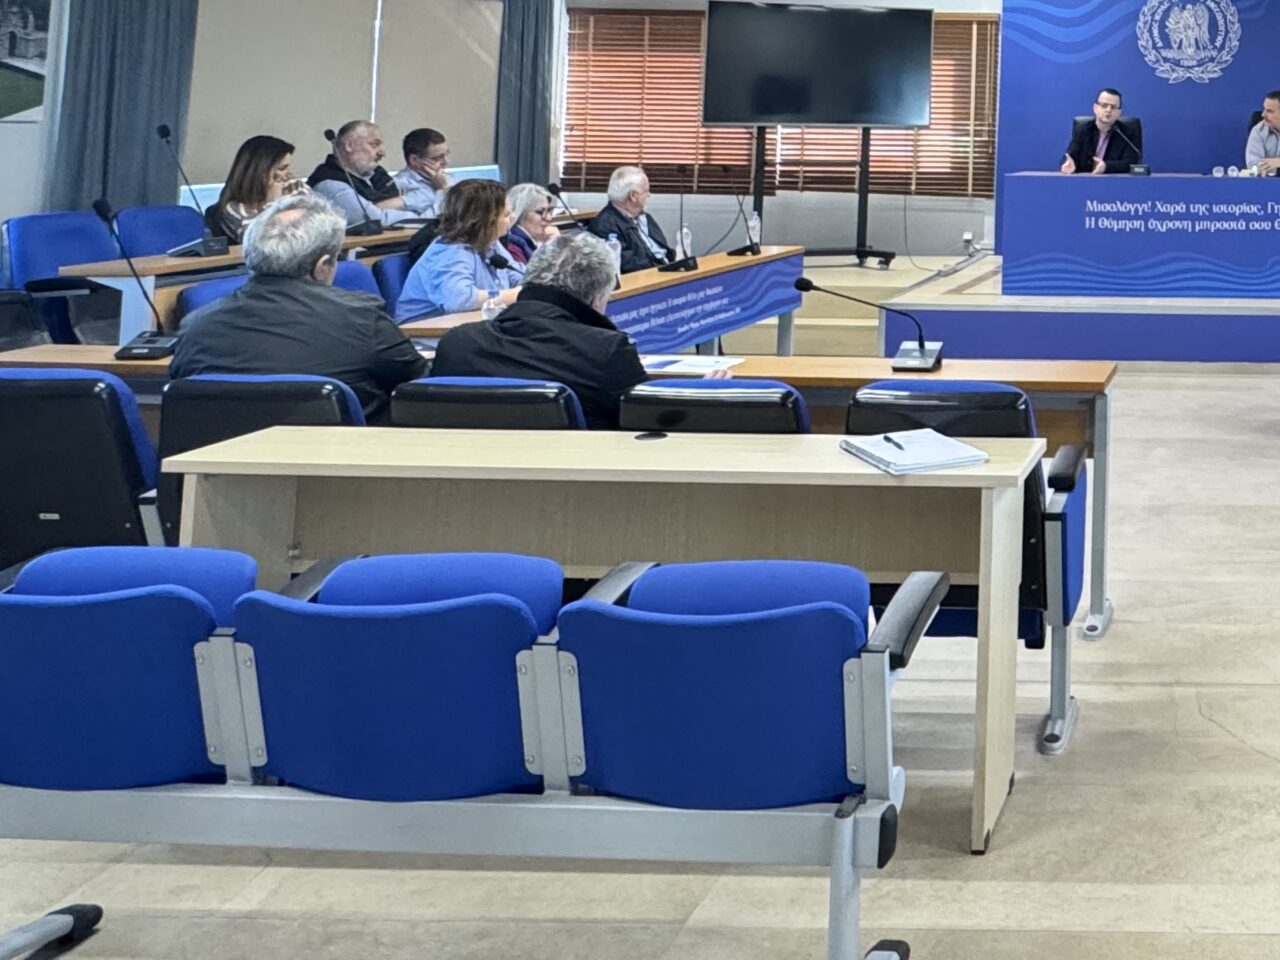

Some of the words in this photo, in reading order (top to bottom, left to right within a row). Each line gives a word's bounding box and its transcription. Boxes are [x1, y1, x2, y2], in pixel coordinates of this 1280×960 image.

[1154, 200, 1186, 216] Χαρά
[1212, 202, 1264, 216] ιστορίας,
[1085, 216, 1095, 229] Η
[1147, 218, 1192, 233] άχρονη
[1195, 218, 1246, 233] μπροστά
[1249, 220, 1272, 231] σου
